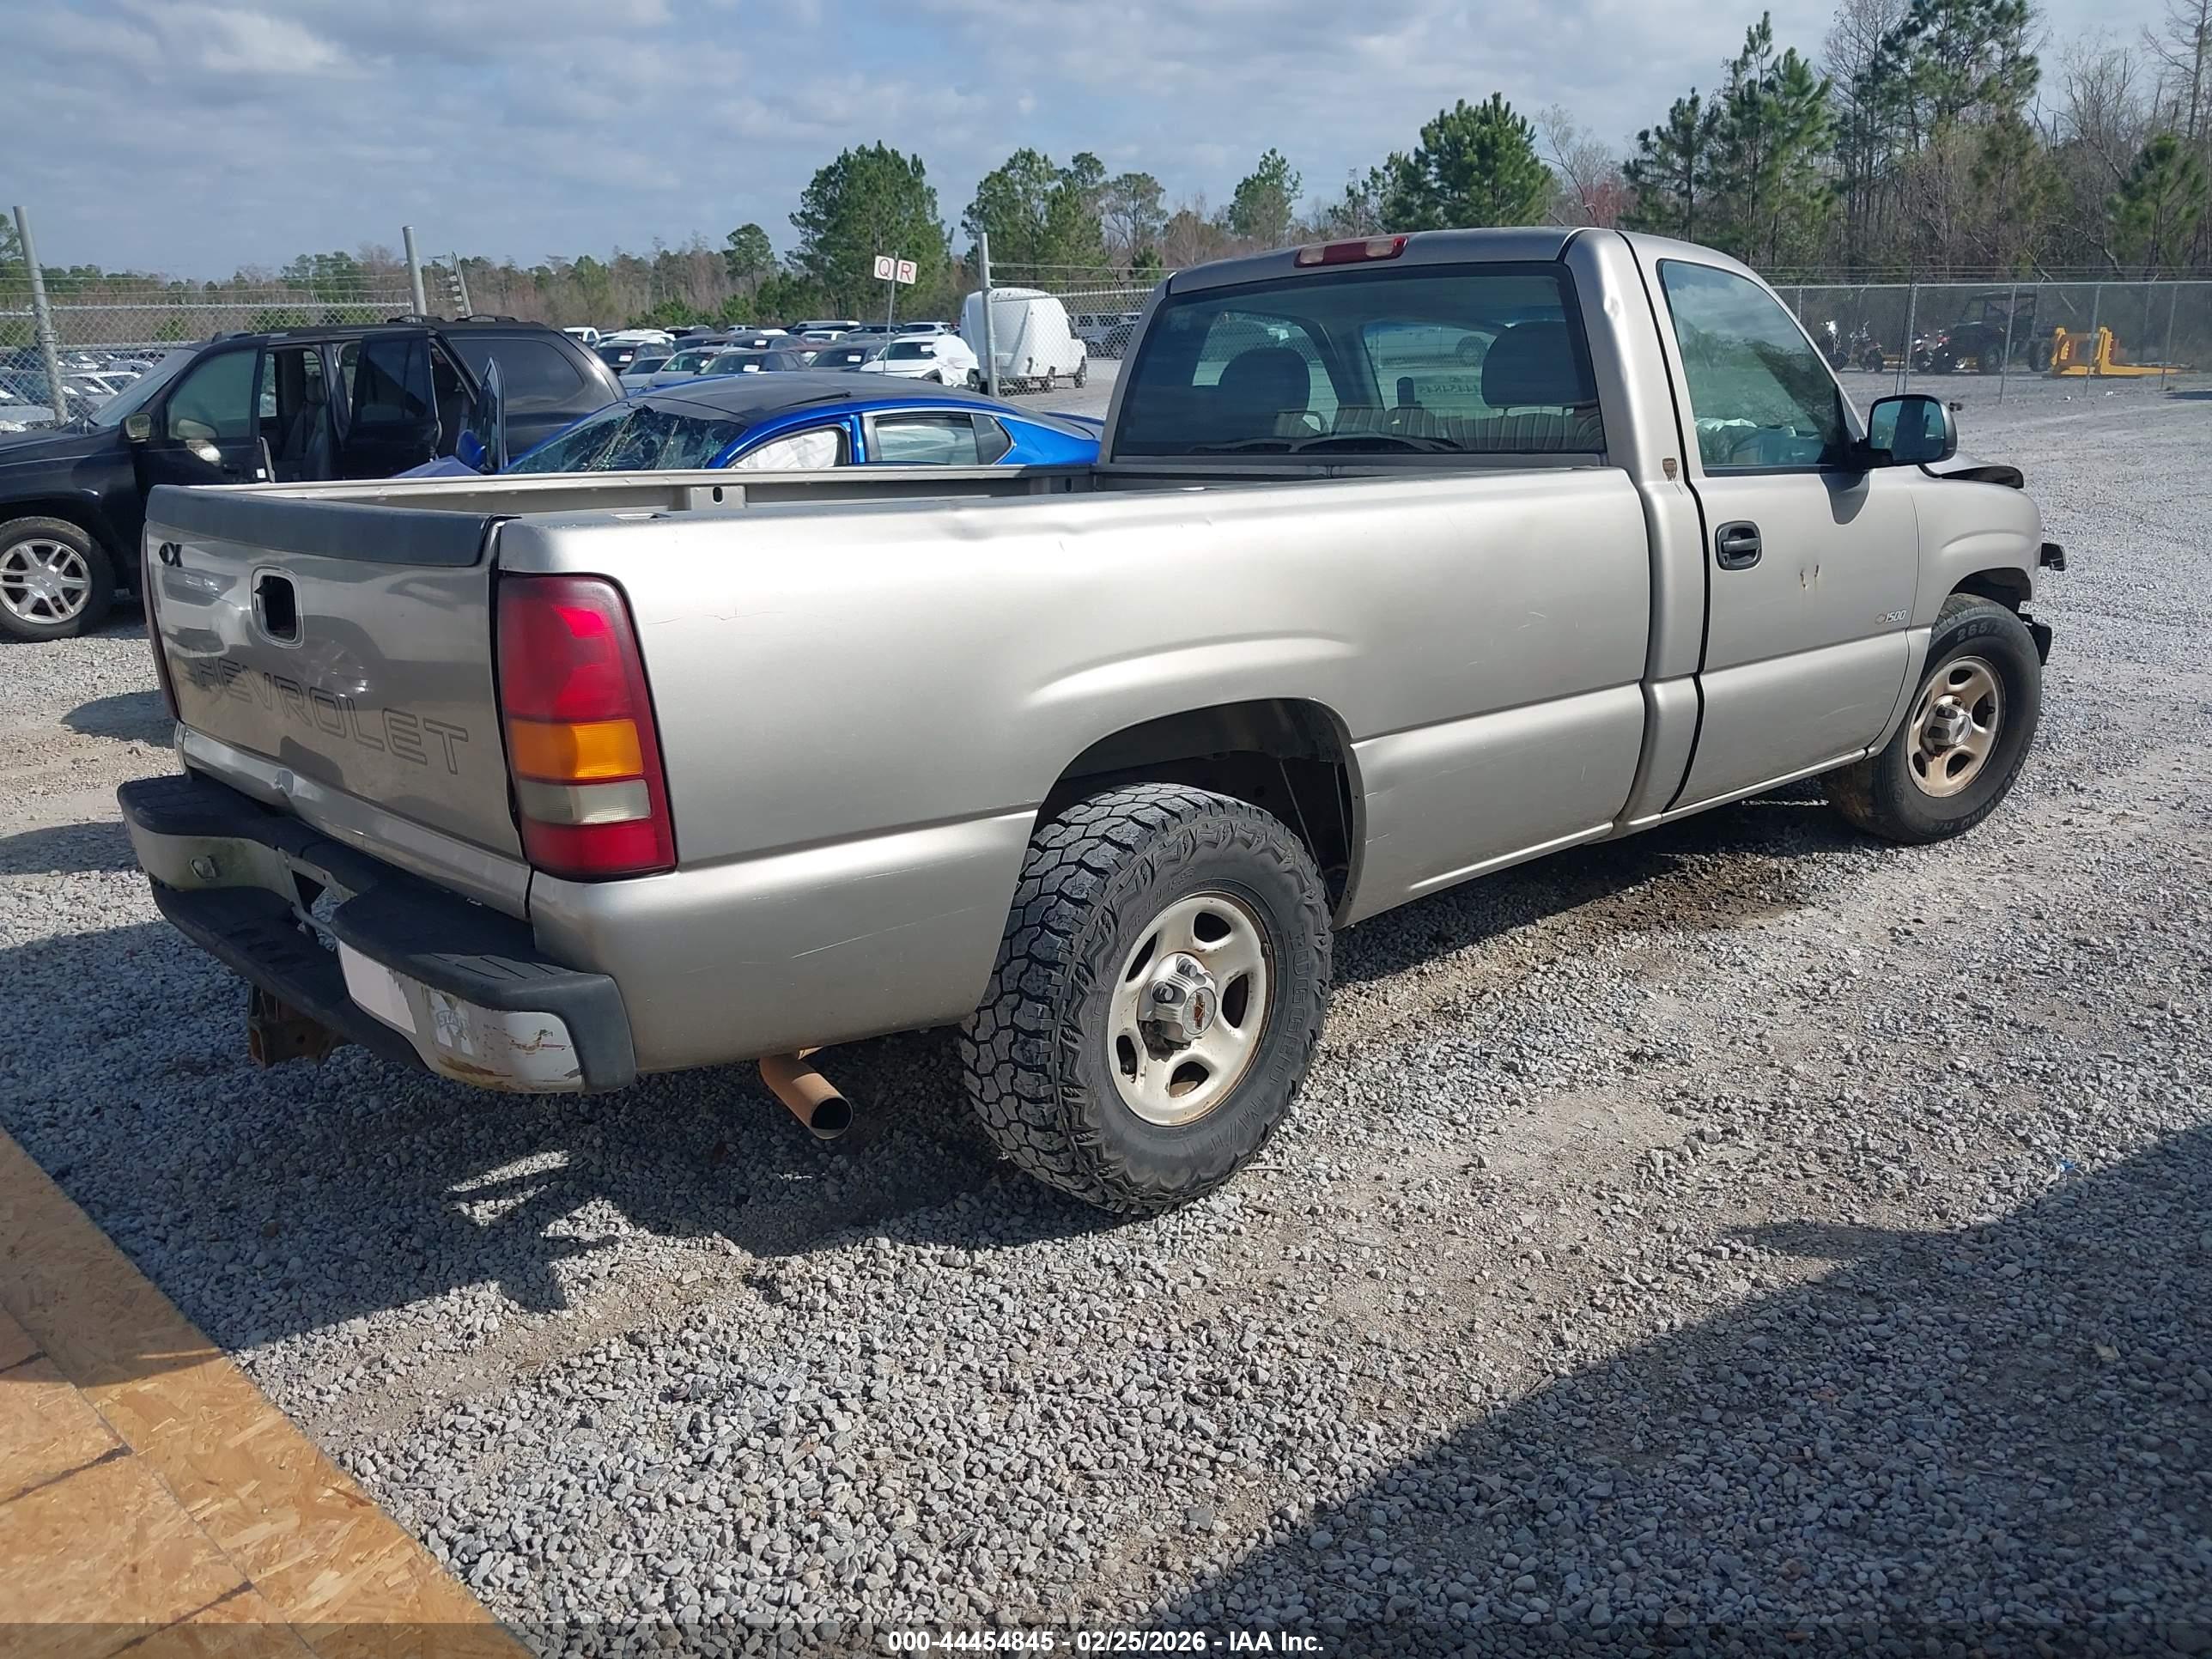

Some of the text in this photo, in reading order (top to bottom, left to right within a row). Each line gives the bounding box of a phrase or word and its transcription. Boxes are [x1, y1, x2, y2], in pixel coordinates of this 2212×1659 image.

[878, 259, 890, 277] Q
[900, 264, 912, 282] R
[1885, 611, 1908, 623] 1500
[180, 656, 469, 775] HEVROLET
